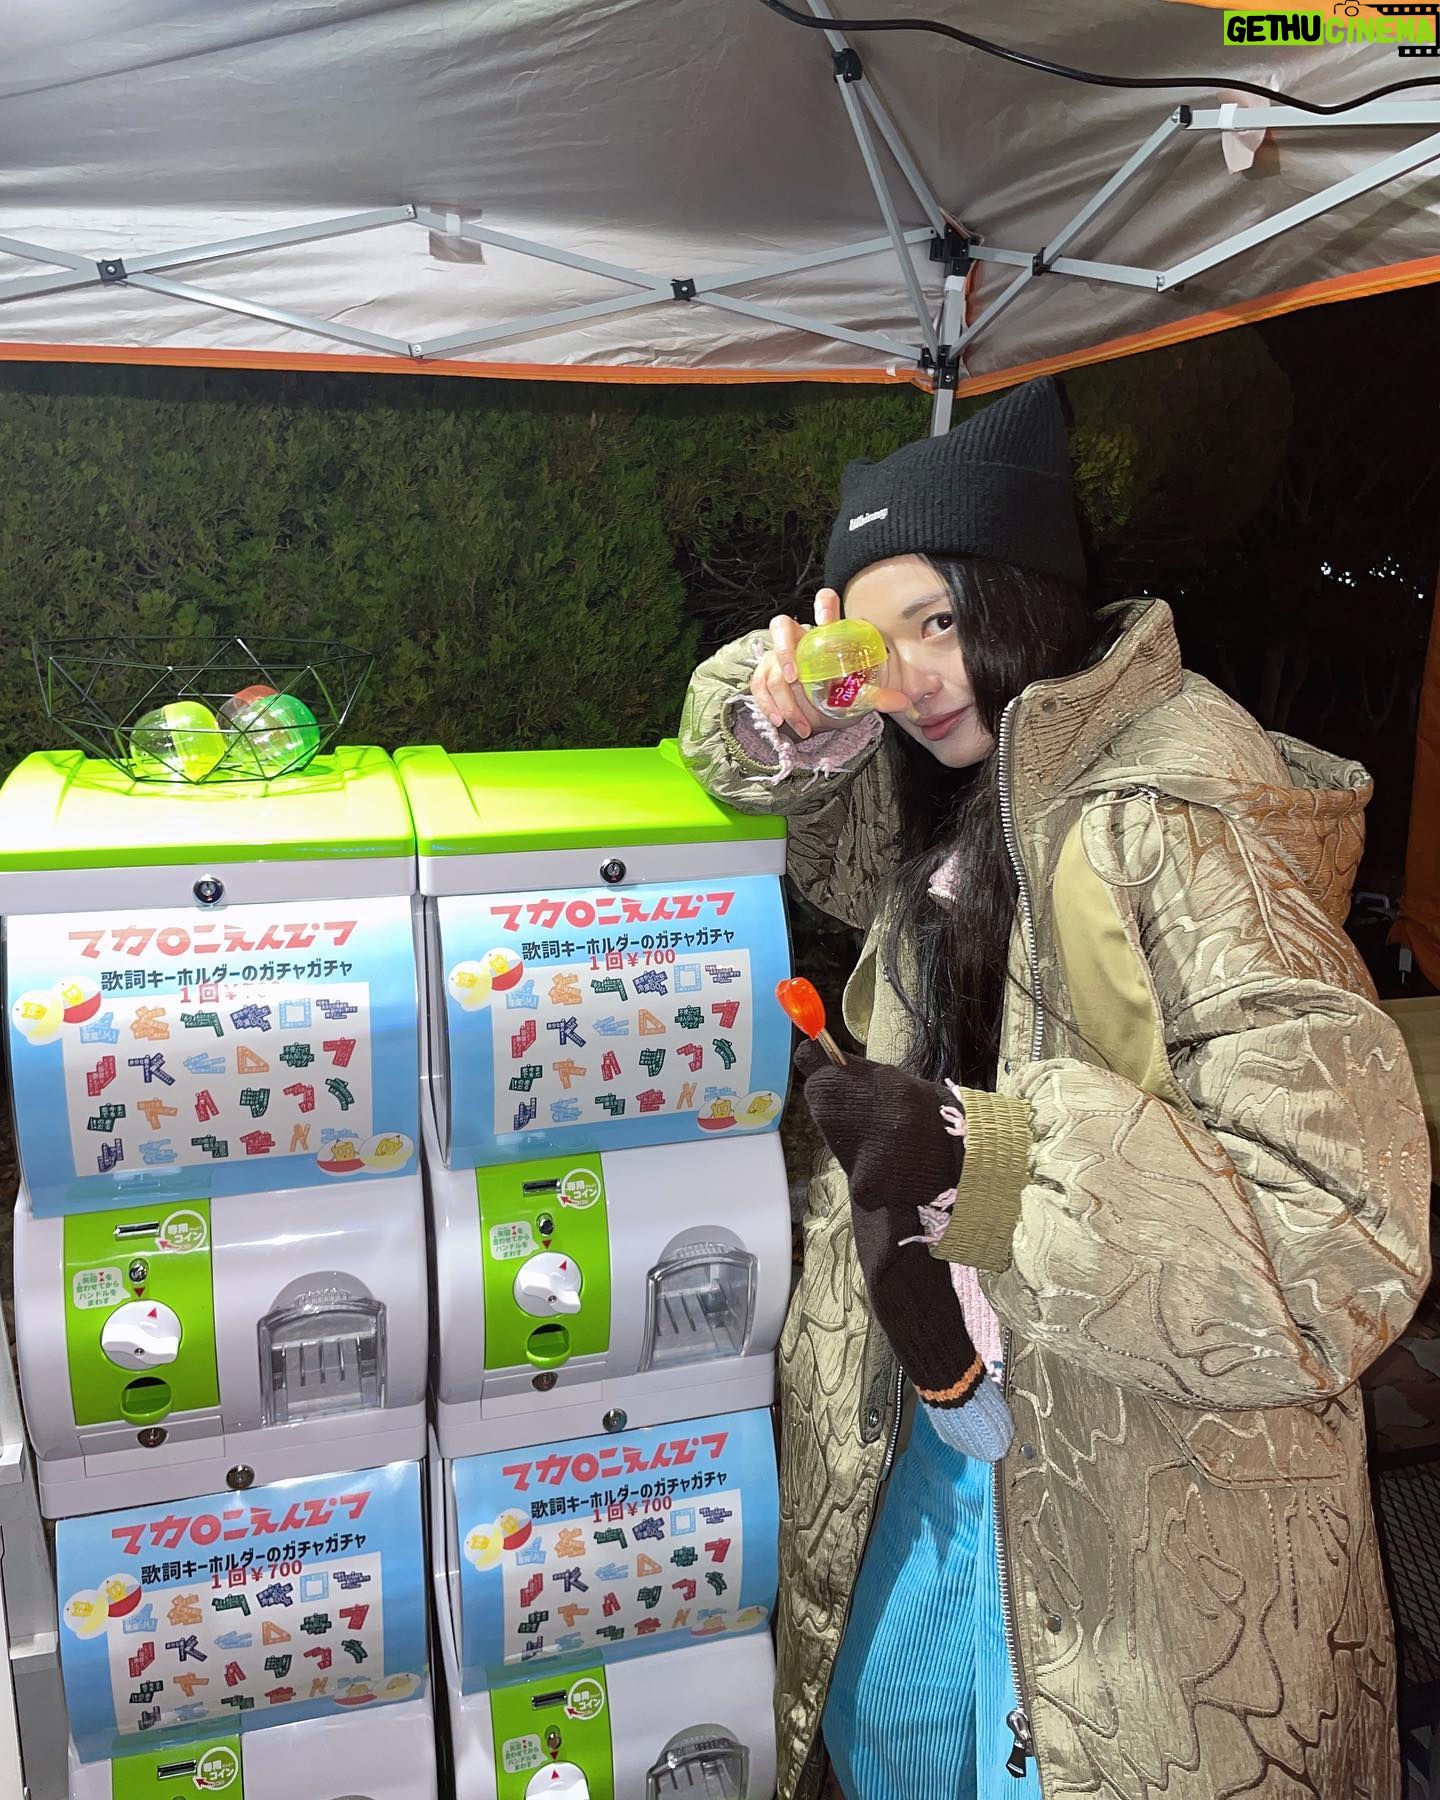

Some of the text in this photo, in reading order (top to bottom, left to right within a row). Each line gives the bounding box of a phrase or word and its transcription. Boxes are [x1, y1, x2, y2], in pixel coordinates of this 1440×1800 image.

[521, 927, 734, 961] 歌詞キーホルダーのガチャガチャ
[101, 958, 352, 991] 歌詞キーホルダーのガチャガチャ
[531, 1471, 727, 1519] 歌詞キーホルダーのガチャガチャ
[141, 1533, 367, 1585] 歌詞キーホルダーのガチャガチャ
